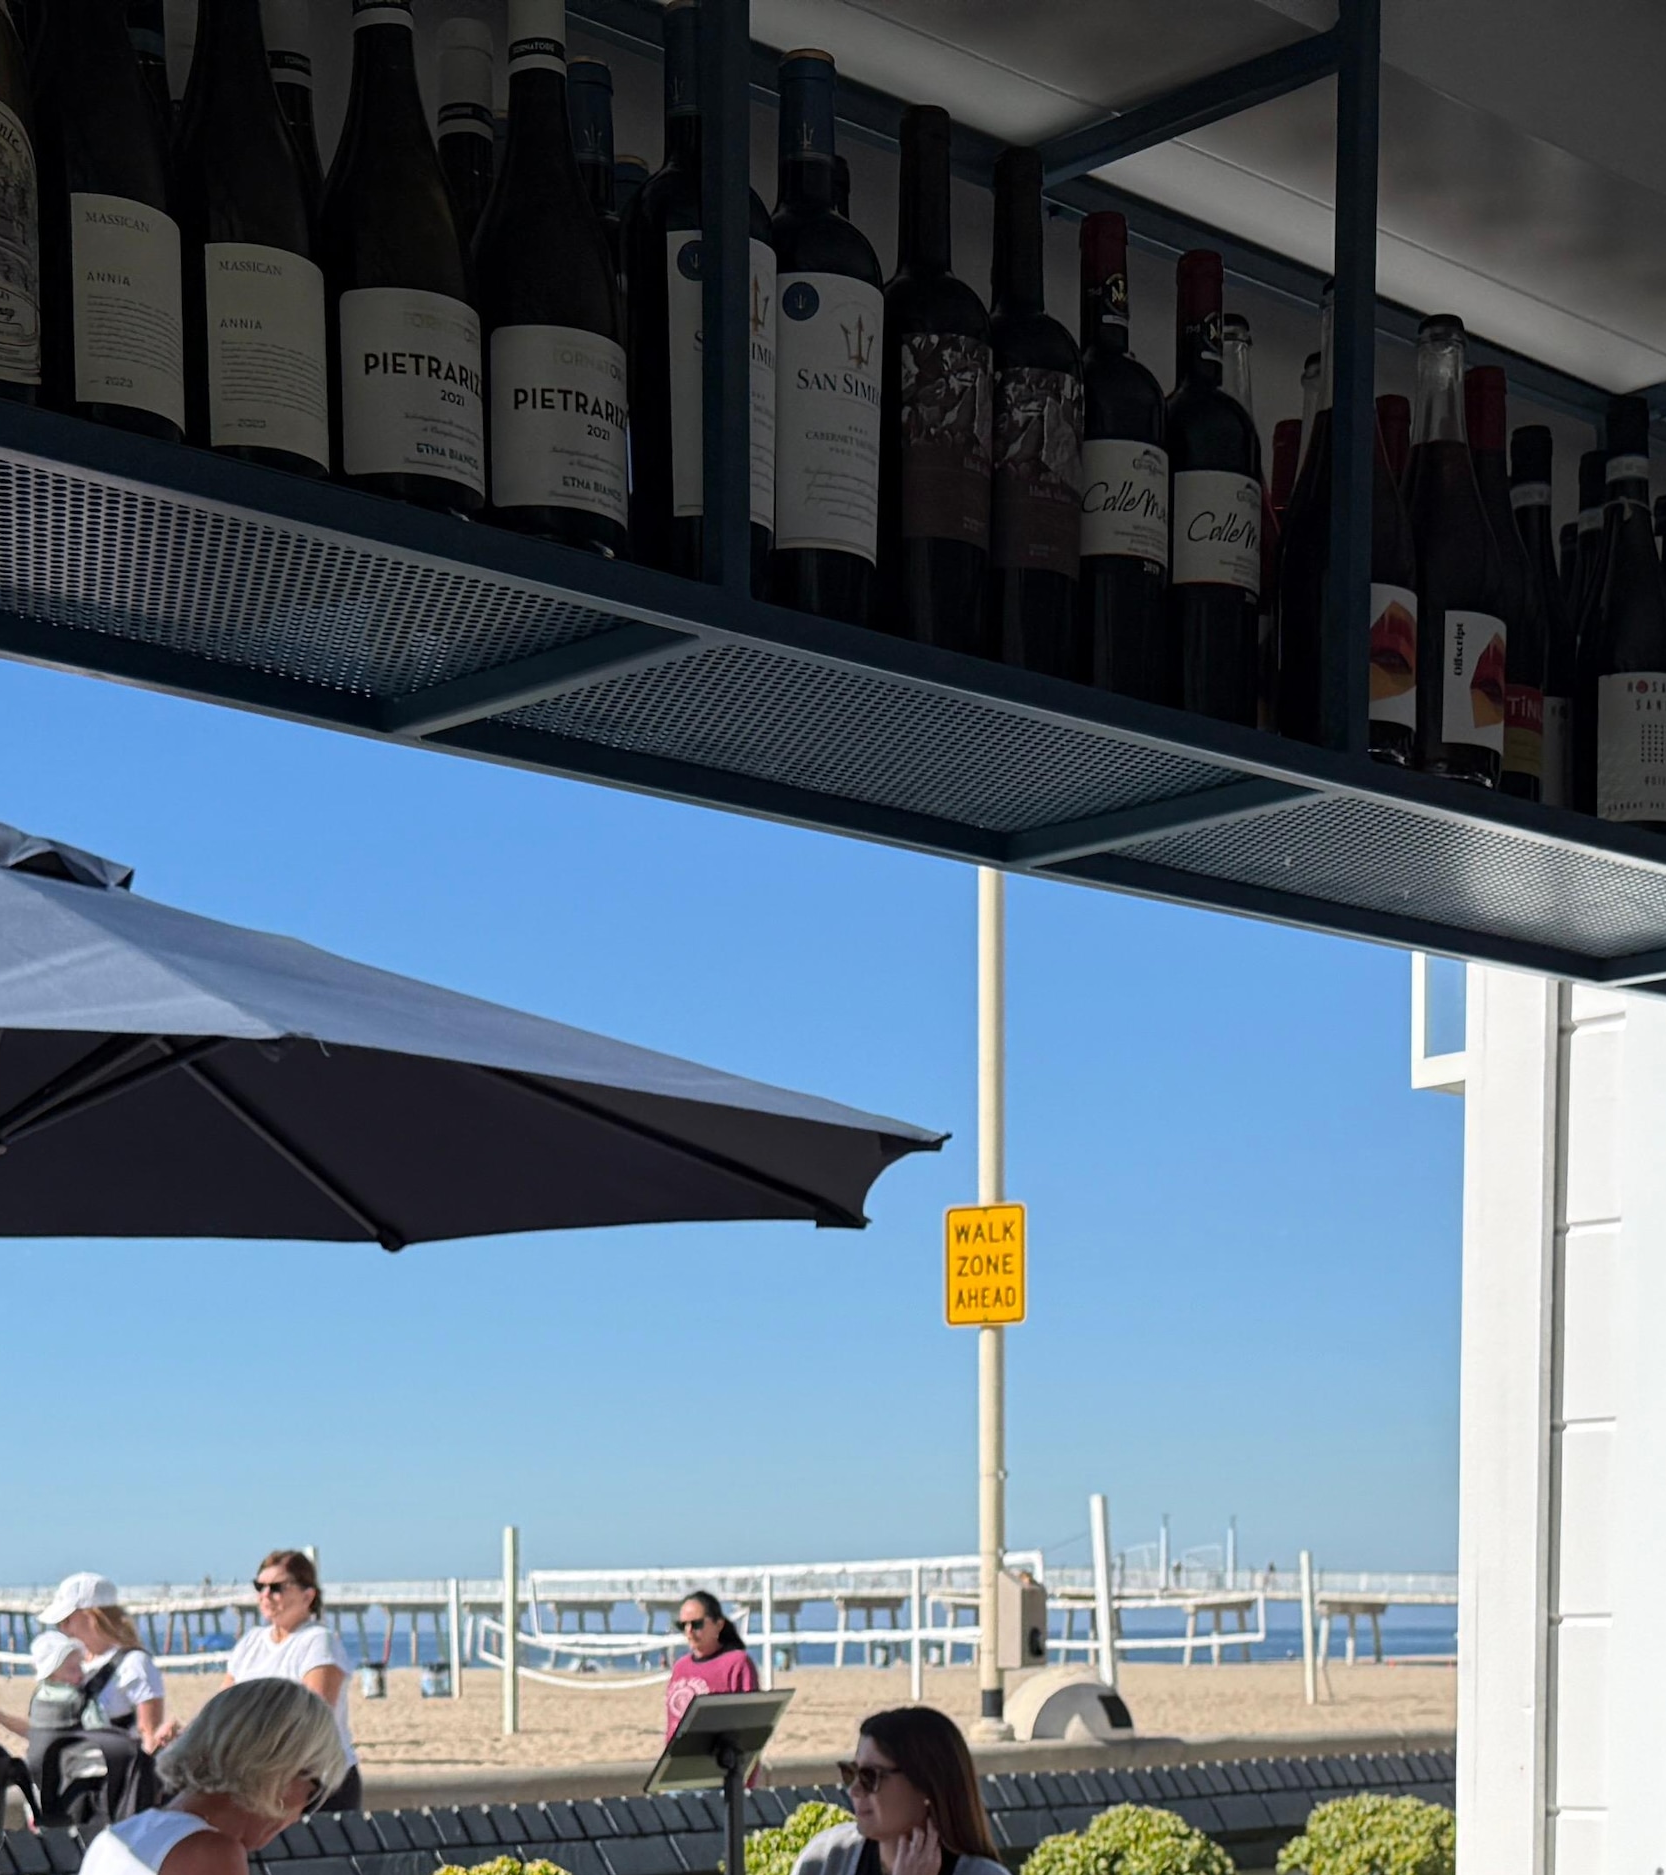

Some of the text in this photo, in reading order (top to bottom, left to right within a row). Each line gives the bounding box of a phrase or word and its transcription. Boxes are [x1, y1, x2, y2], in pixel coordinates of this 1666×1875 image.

[85, 211, 150, 234] MASSICAN
[219, 259, 282, 277] MASSICAN
[87, 271, 131, 287] ANNIA
[220, 318, 263, 332] ANNIA
[797, 368, 837, 391] SAN
[440, 389, 465, 407] 2021
[587, 424, 610, 441] 2021
[954, 1220, 1016, 1244] WALK
[957, 1253, 1014, 1277] ZONE
[955, 1285, 1017, 1309] AHEAD
